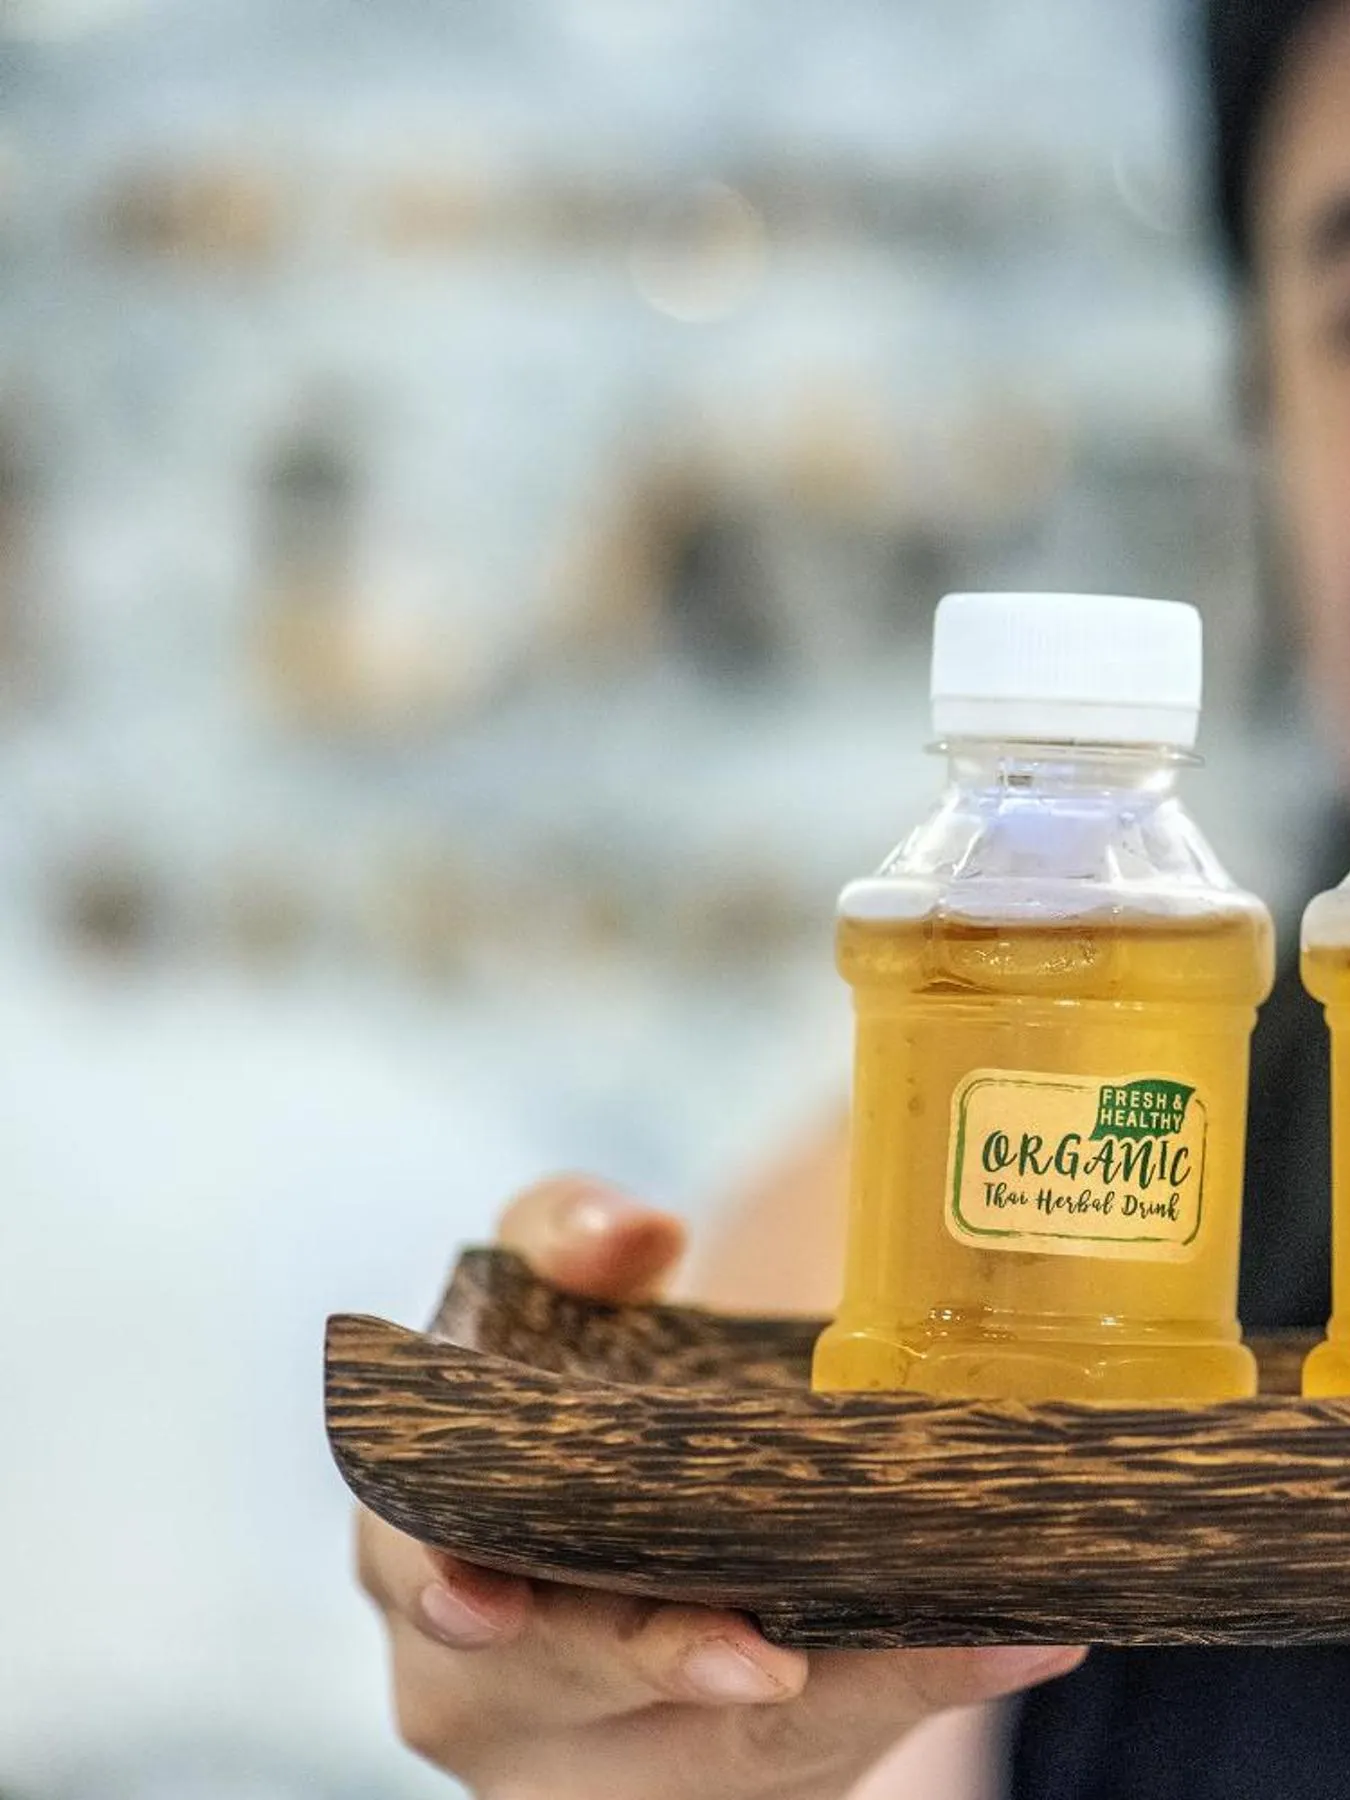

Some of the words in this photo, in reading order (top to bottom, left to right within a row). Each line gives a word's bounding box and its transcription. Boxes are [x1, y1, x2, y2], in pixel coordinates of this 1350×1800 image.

[1102, 1088, 1168, 1110] FRESH
[1172, 1094, 1183, 1110] &
[1100, 1108, 1184, 1131] HEALTHY
[981, 1129, 1191, 1190] ORGANIC
[983, 1181, 1029, 1209] Thai
[1035, 1187, 1115, 1217] Herbal
[1120, 1191, 1181, 1221] Drink
